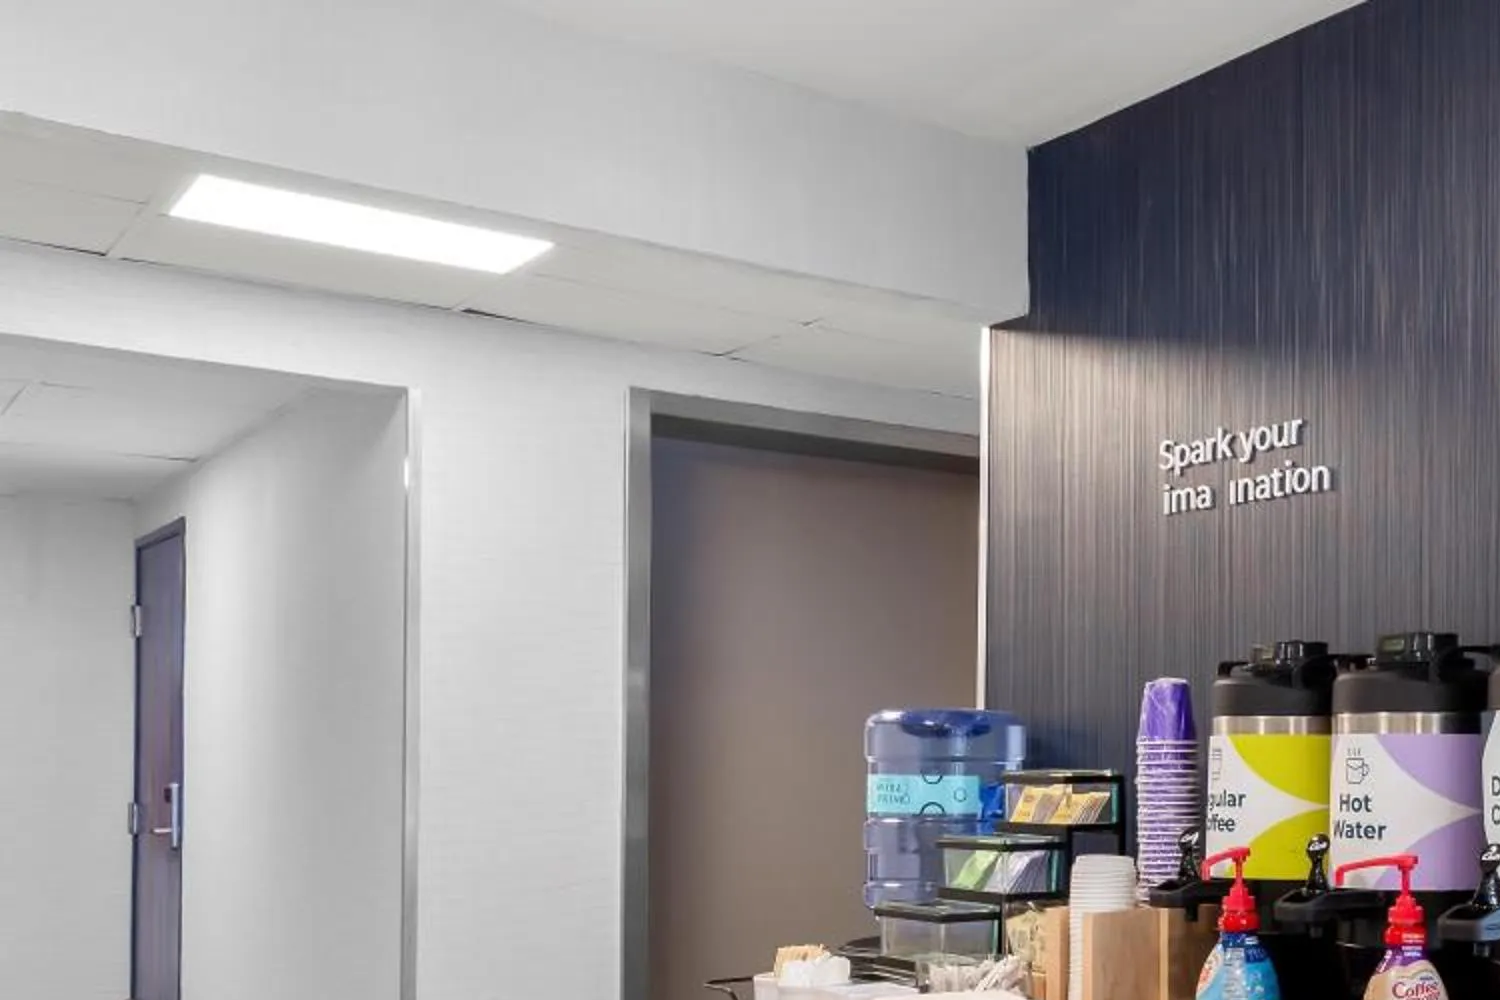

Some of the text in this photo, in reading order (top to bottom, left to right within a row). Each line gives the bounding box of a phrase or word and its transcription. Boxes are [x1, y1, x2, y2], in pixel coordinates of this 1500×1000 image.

[1159, 419, 1303, 476] Spark your
[1208, 789, 1247, 811] gular
[1339, 793, 1373, 813] Hot
[1333, 819, 1387, 841] Water
